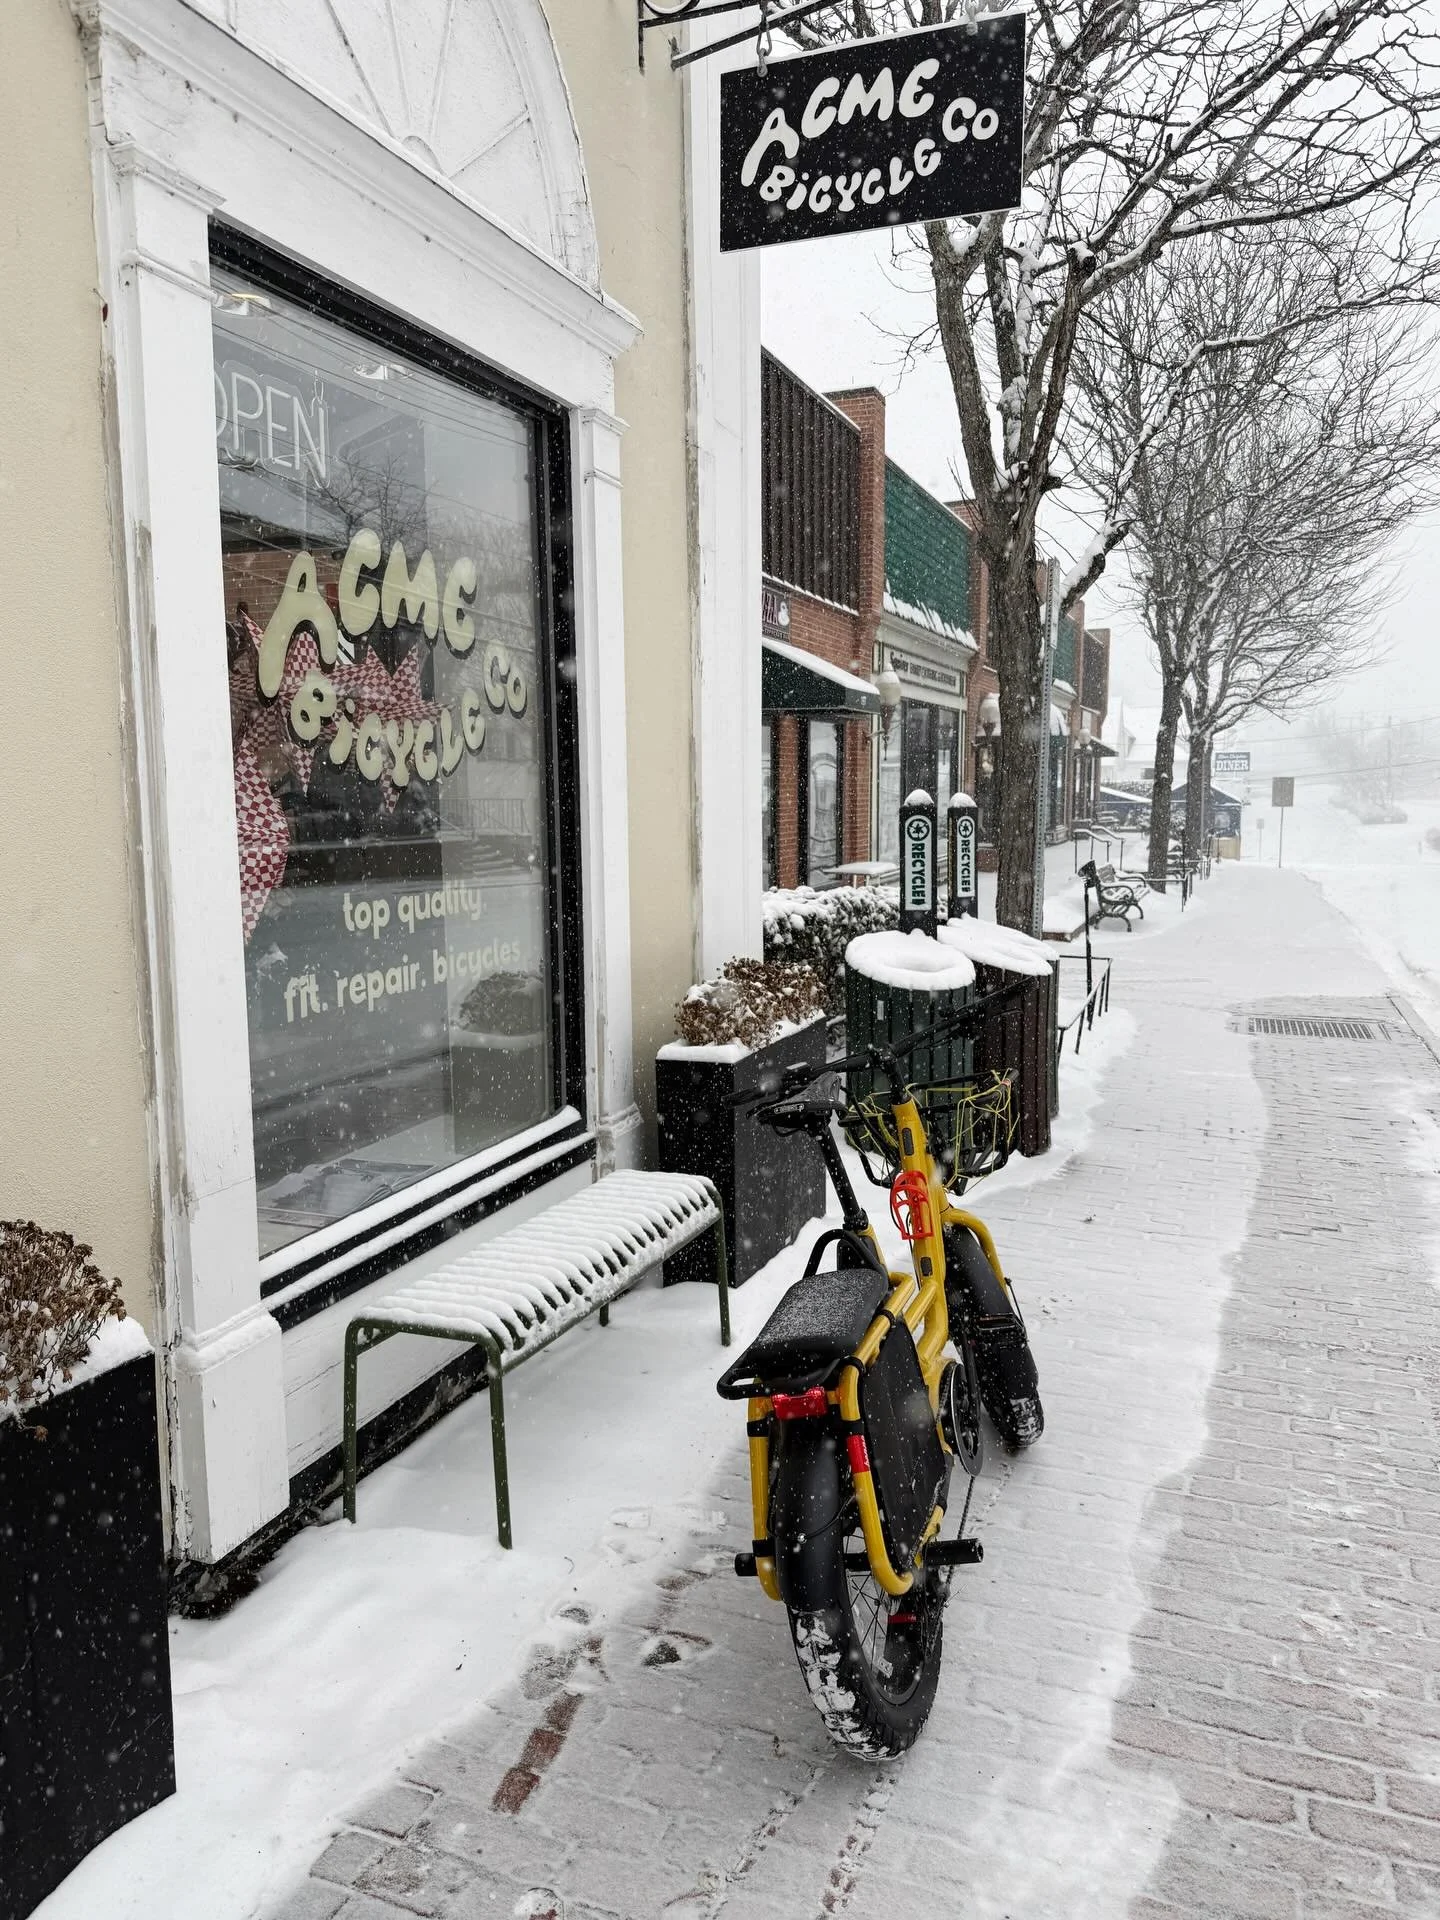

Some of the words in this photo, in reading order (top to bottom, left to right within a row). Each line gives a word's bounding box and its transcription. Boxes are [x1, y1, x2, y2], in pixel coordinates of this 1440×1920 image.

[741, 58, 940, 187] ACME
[257, 527, 477, 699] ACME
[1215, 760, 1249, 771] DINER
[343, 892, 390, 939] top
[432, 938, 521, 986] bicycles
